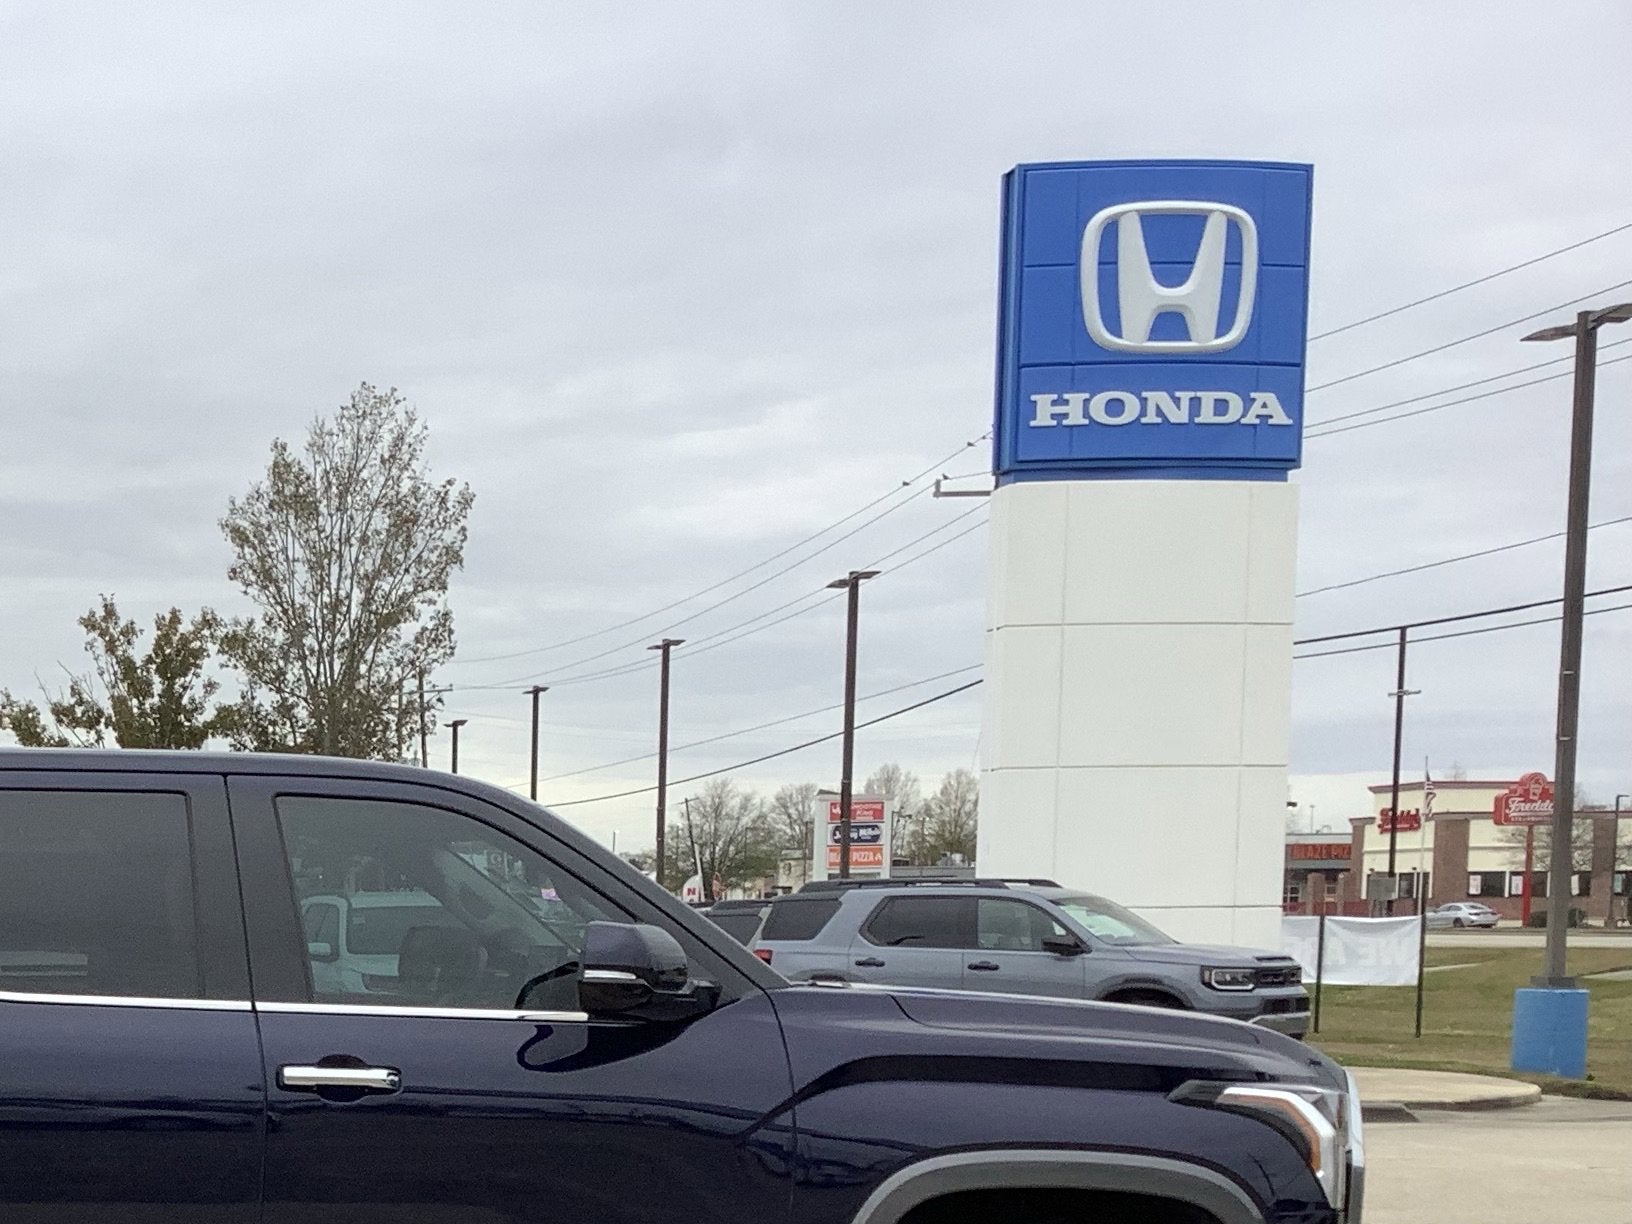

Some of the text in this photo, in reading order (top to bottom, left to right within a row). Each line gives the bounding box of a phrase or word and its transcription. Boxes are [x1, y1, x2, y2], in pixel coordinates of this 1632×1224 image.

[1030, 391, 1293, 427] HONDA
[1508, 797, 1554, 812] Fredd
[1330, 844, 1352, 860] PIZ
